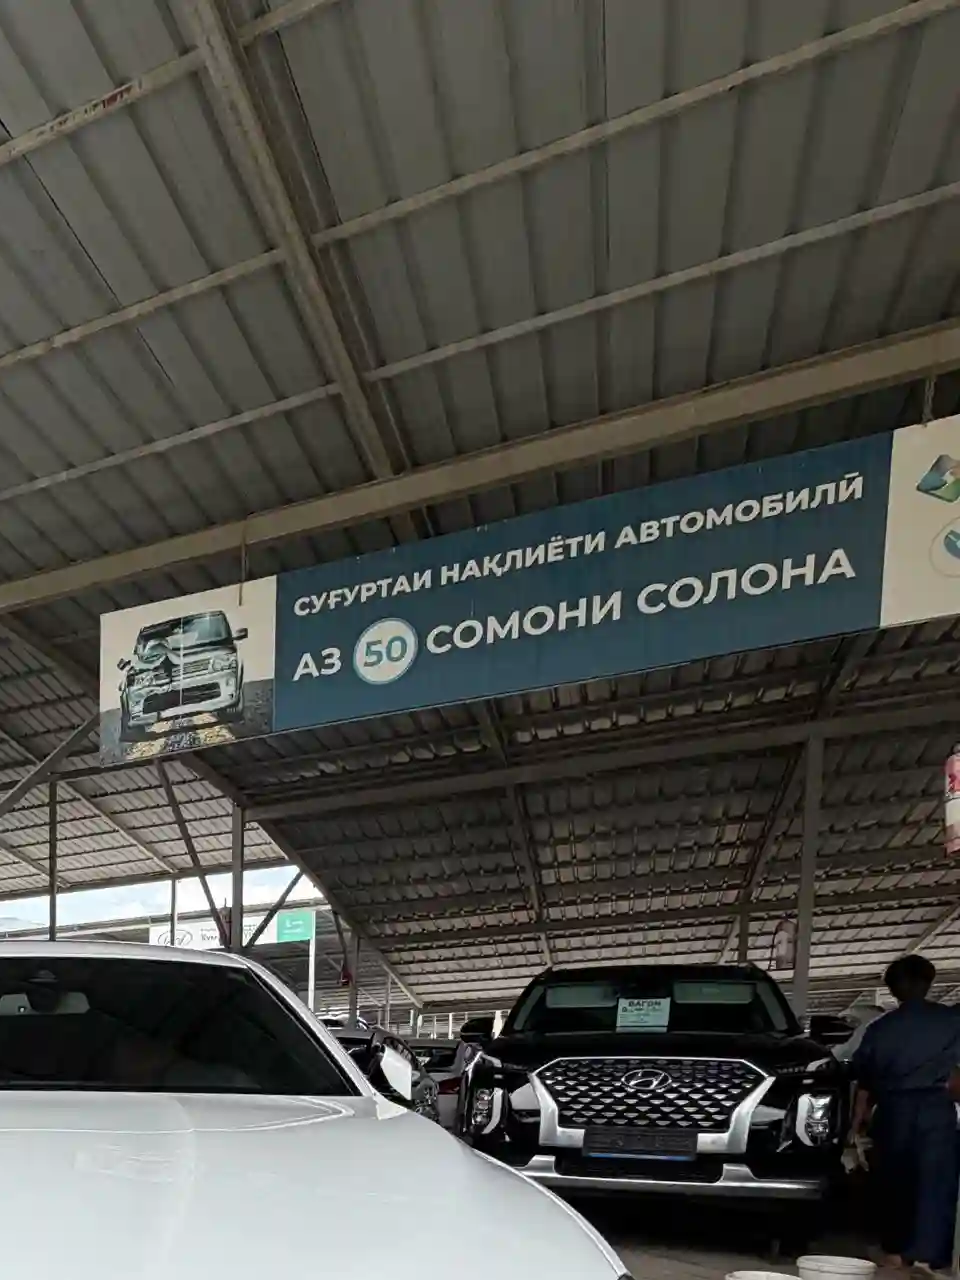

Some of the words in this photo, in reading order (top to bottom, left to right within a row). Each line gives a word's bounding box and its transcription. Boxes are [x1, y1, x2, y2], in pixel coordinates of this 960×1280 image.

[293, 568, 432, 617] СУҒУРТАИ
[440, 531, 606, 587] НАҚЛИЁТИ
[614, 471, 864, 549] АВТОМОБИЛӢ
[292, 647, 342, 682] АЗ
[362, 634, 409, 669] 50
[426, 590, 622, 654] СОМОНИ
[636, 548, 857, 615] СОЛОНА
